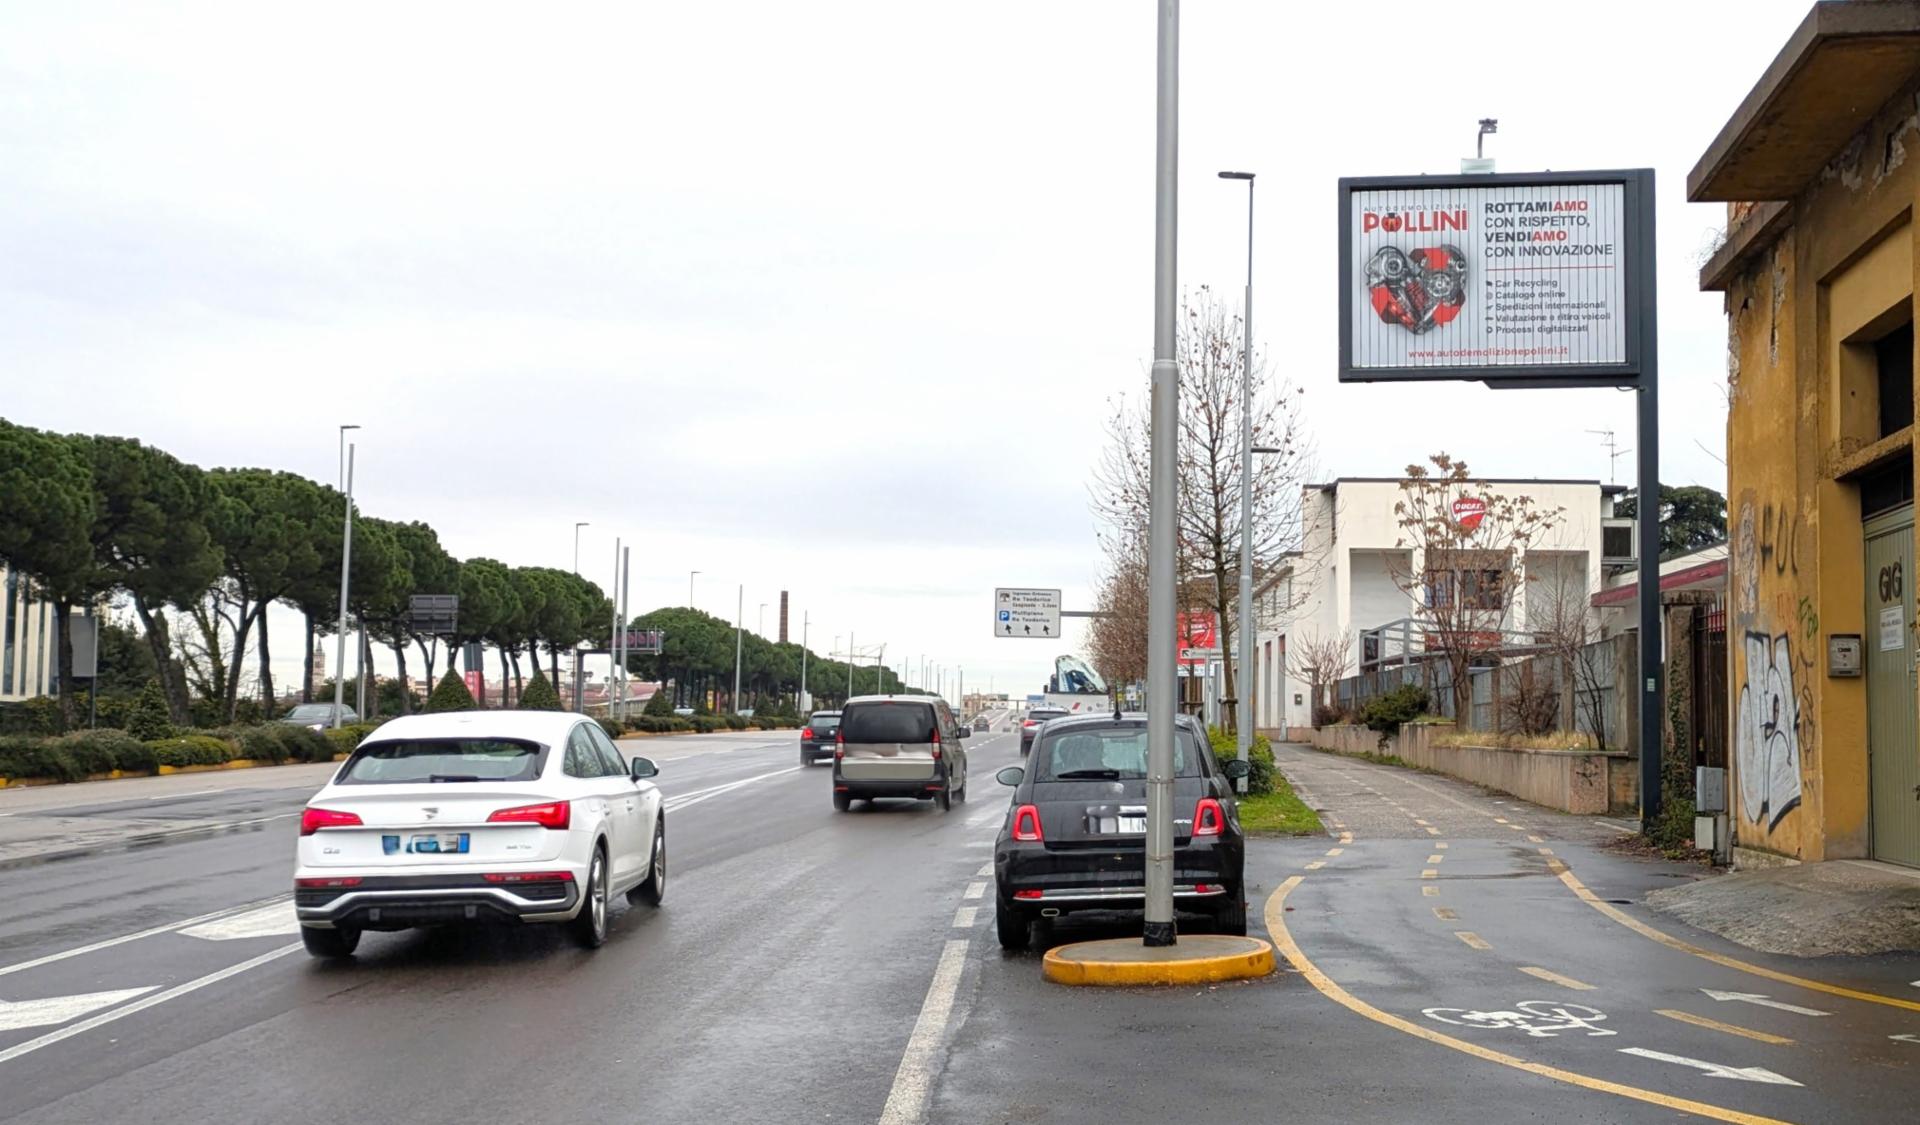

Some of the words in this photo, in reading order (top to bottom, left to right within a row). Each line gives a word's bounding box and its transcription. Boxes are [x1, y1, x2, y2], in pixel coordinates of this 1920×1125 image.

[1363, 203, 1467, 212] AUTODEMOLIZIONE
[1484, 200, 1589, 214] ROTTAMIAMO
[1363, 210, 1468, 233] POLLINI
[1484, 217, 1514, 229] CON
[1518, 215, 1591, 228] RISPETTO,
[1484, 231, 1568, 243] VENDIAMO
[1484, 246, 1514, 258] CON
[1518, 244, 1614, 257] INNOVAZIONE
[1495, 280, 1511, 288] Car
[1513, 279, 1558, 289] Recycling
[1495, 290, 1536, 300] Catalogo
[1537, 289, 1566, 298] online
[1495, 302, 1543, 312] Spedizioni
[1544, 300, 1606, 310] internazionali
[1495, 313, 1547, 322] Valutazione
[1557, 313, 1580, 321] ritiro
[1581, 312, 1611, 321] veicoli
[1495, 325, 1535, 334] Processi
[1537, 324, 1589, 334] digitalizzati
[1408, 346, 1568, 358] www.autodemolizionepollini.it
